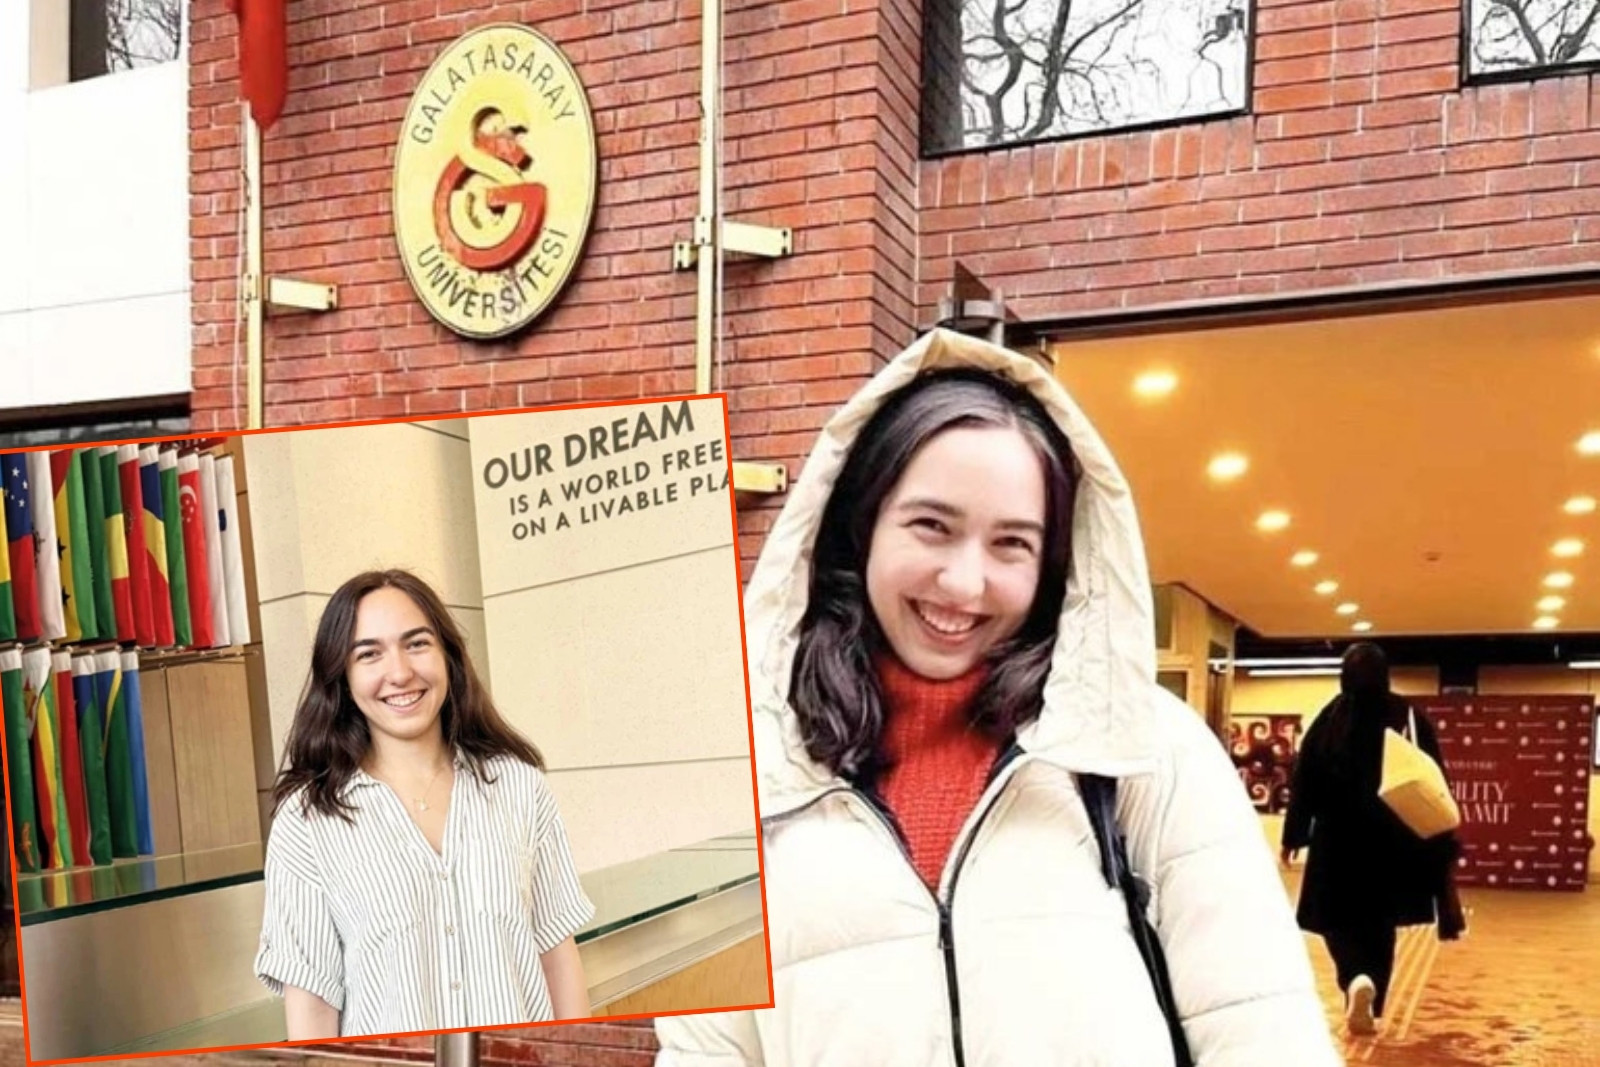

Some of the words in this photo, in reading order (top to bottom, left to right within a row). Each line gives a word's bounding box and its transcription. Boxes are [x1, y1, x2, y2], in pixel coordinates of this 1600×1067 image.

[411, 42, 576, 145] GALATASARAY
[483, 443, 554, 489] OUR
[564, 401, 695, 468] DREAM
[510, 494, 529, 516] IS
[538, 488, 553, 509] A
[561, 461, 651, 501] WORLD
[662, 439, 723, 475] FREE
[512, 517, 546, 540] ON
[555, 512, 571, 531] A
[580, 482, 678, 524] LIVABLE
